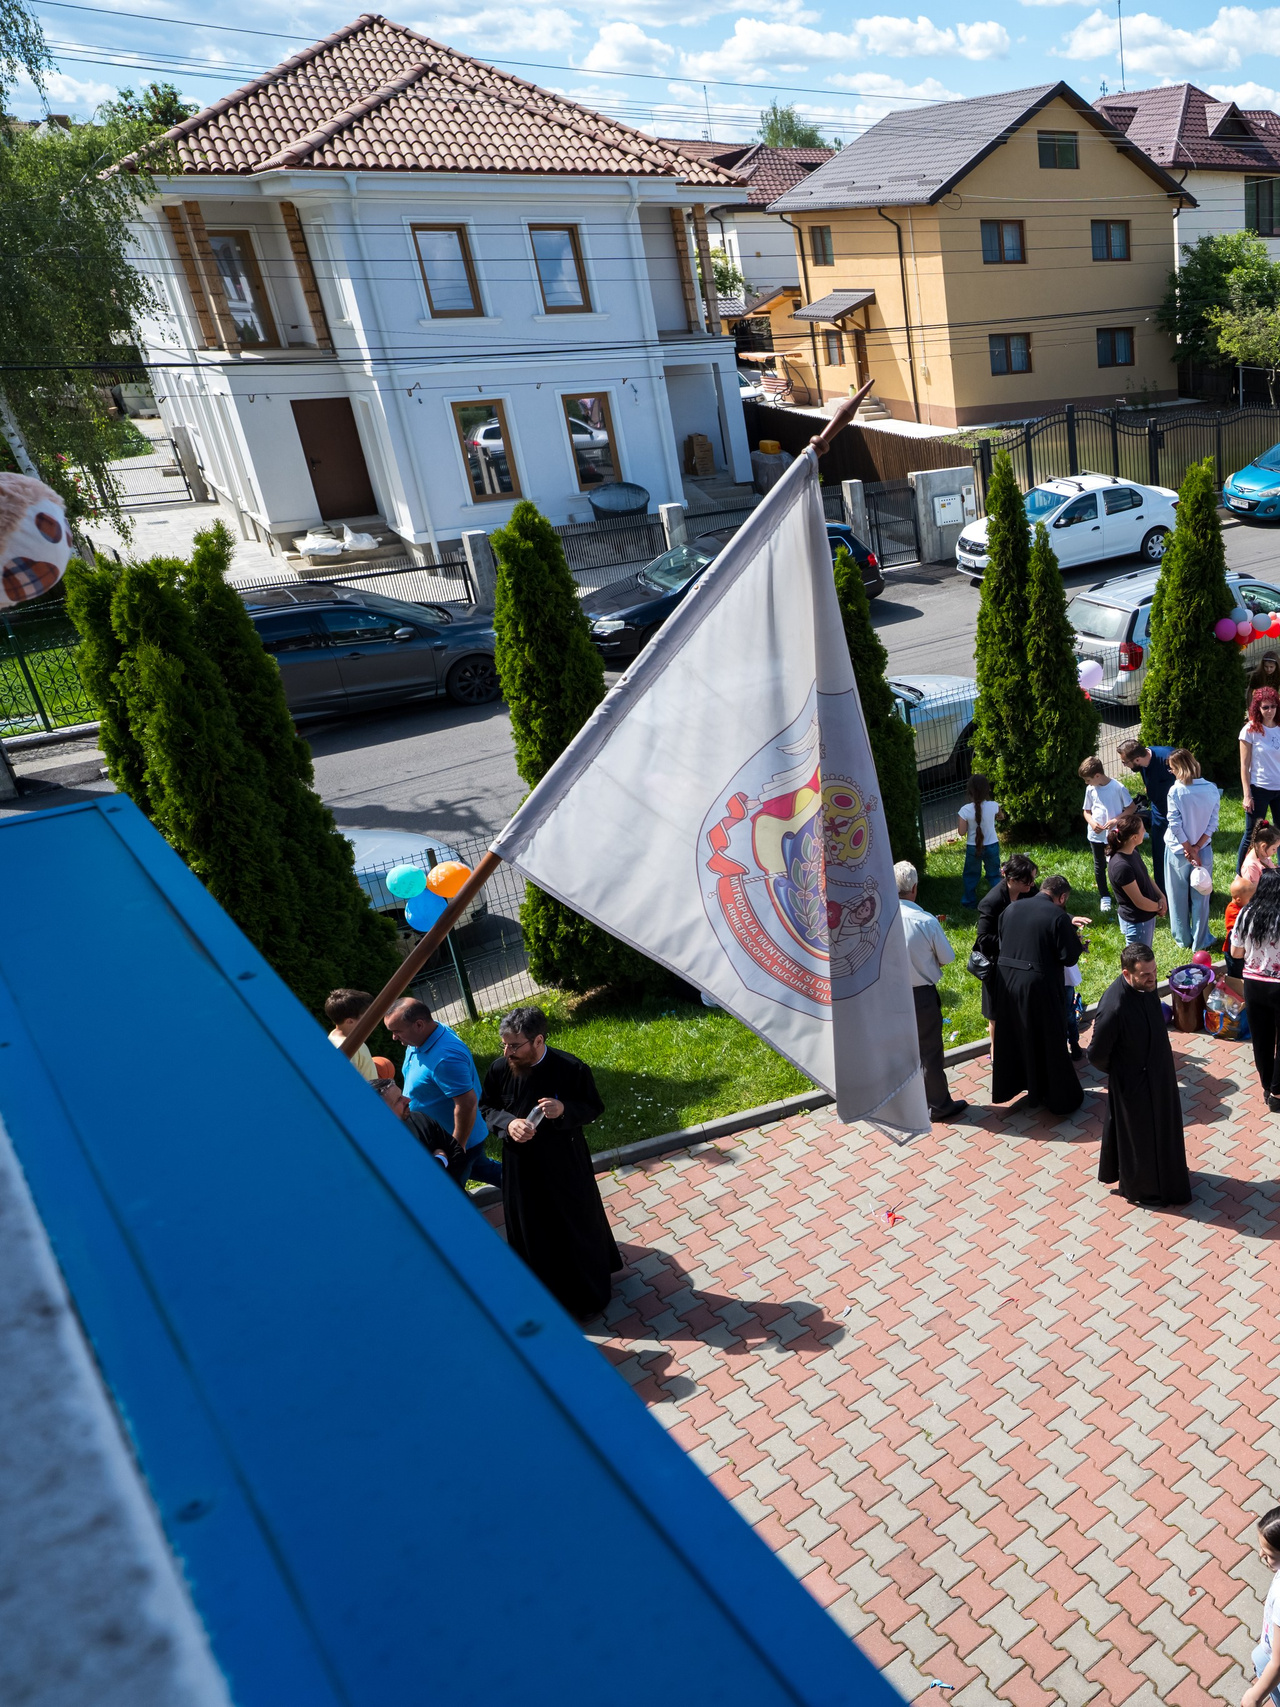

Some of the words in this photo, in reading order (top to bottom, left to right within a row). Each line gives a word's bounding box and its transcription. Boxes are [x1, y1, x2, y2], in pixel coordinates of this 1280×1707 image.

[726, 903, 772, 967] ARHIEPISCOPIA
[729, 875, 759, 936] MITROPOLIA
[756, 934, 804, 977] MUNTENIEI
[815, 980, 832, 991] DO
